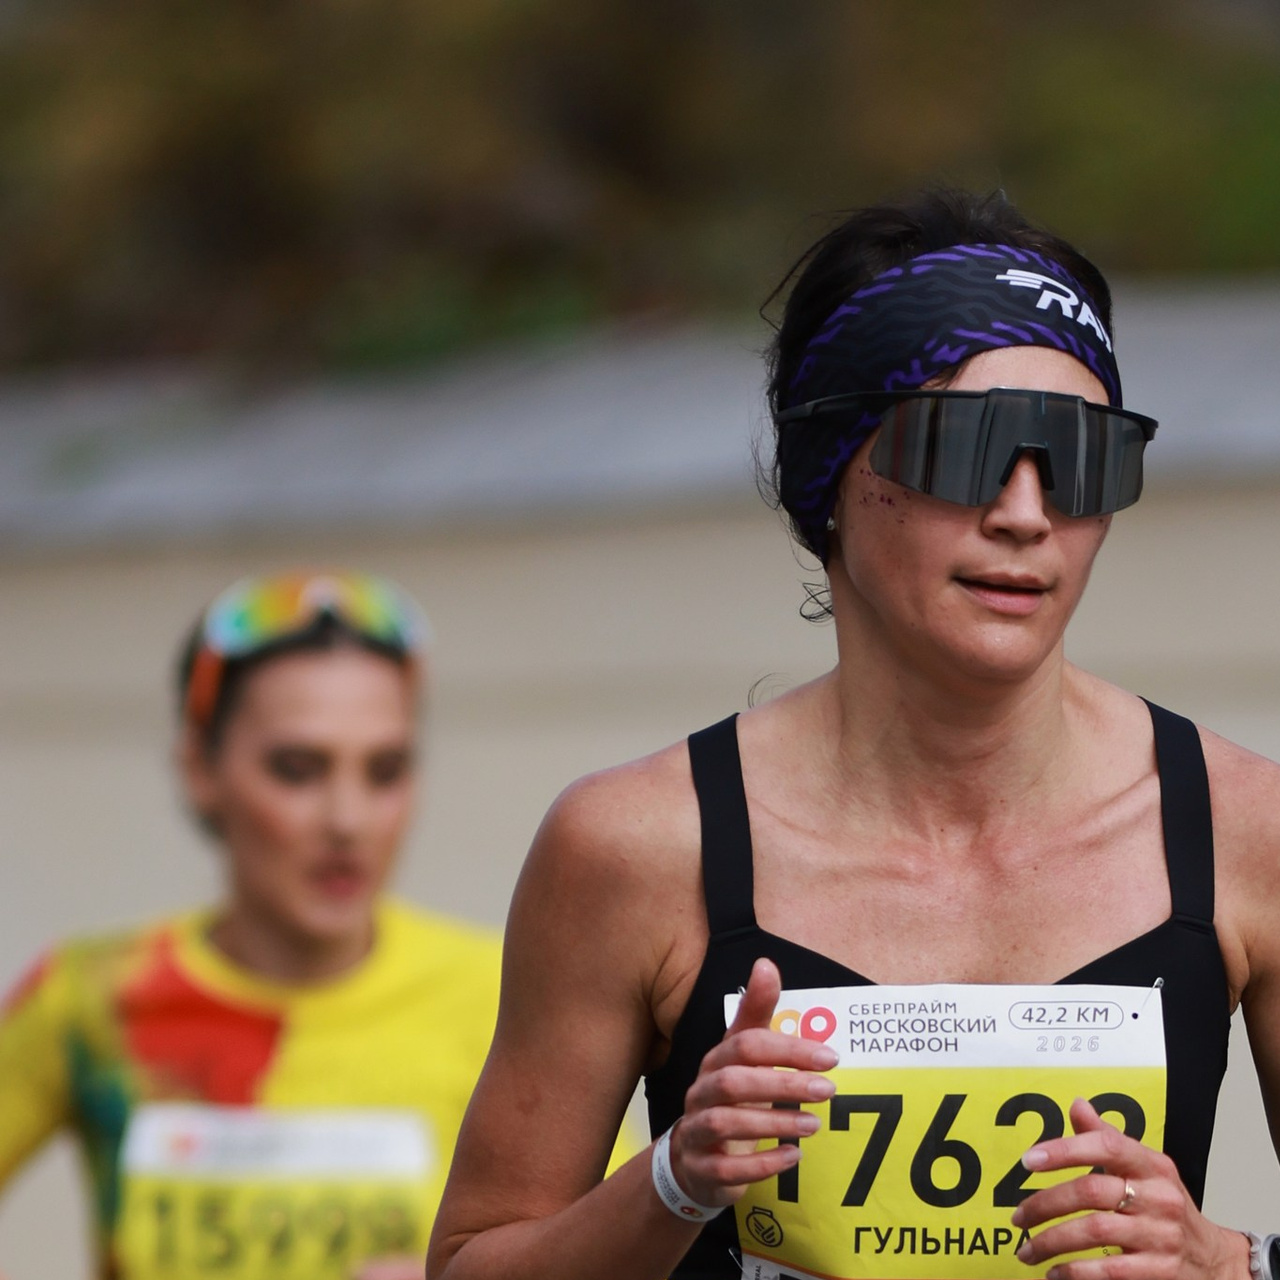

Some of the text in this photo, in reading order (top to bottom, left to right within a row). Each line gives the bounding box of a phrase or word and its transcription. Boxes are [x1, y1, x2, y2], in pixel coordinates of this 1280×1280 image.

[996, 269, 1112, 353] RA
[849, 1000, 957, 1015] СБЕРПРАЙМ
[1021, 1007, 1109, 1025] 42,2 КМ
[849, 1015, 997, 1034] МОСКОВСКИЙ
[850, 1037, 958, 1053] МАРАФОН
[1036, 1035, 1100, 1052] 2026
